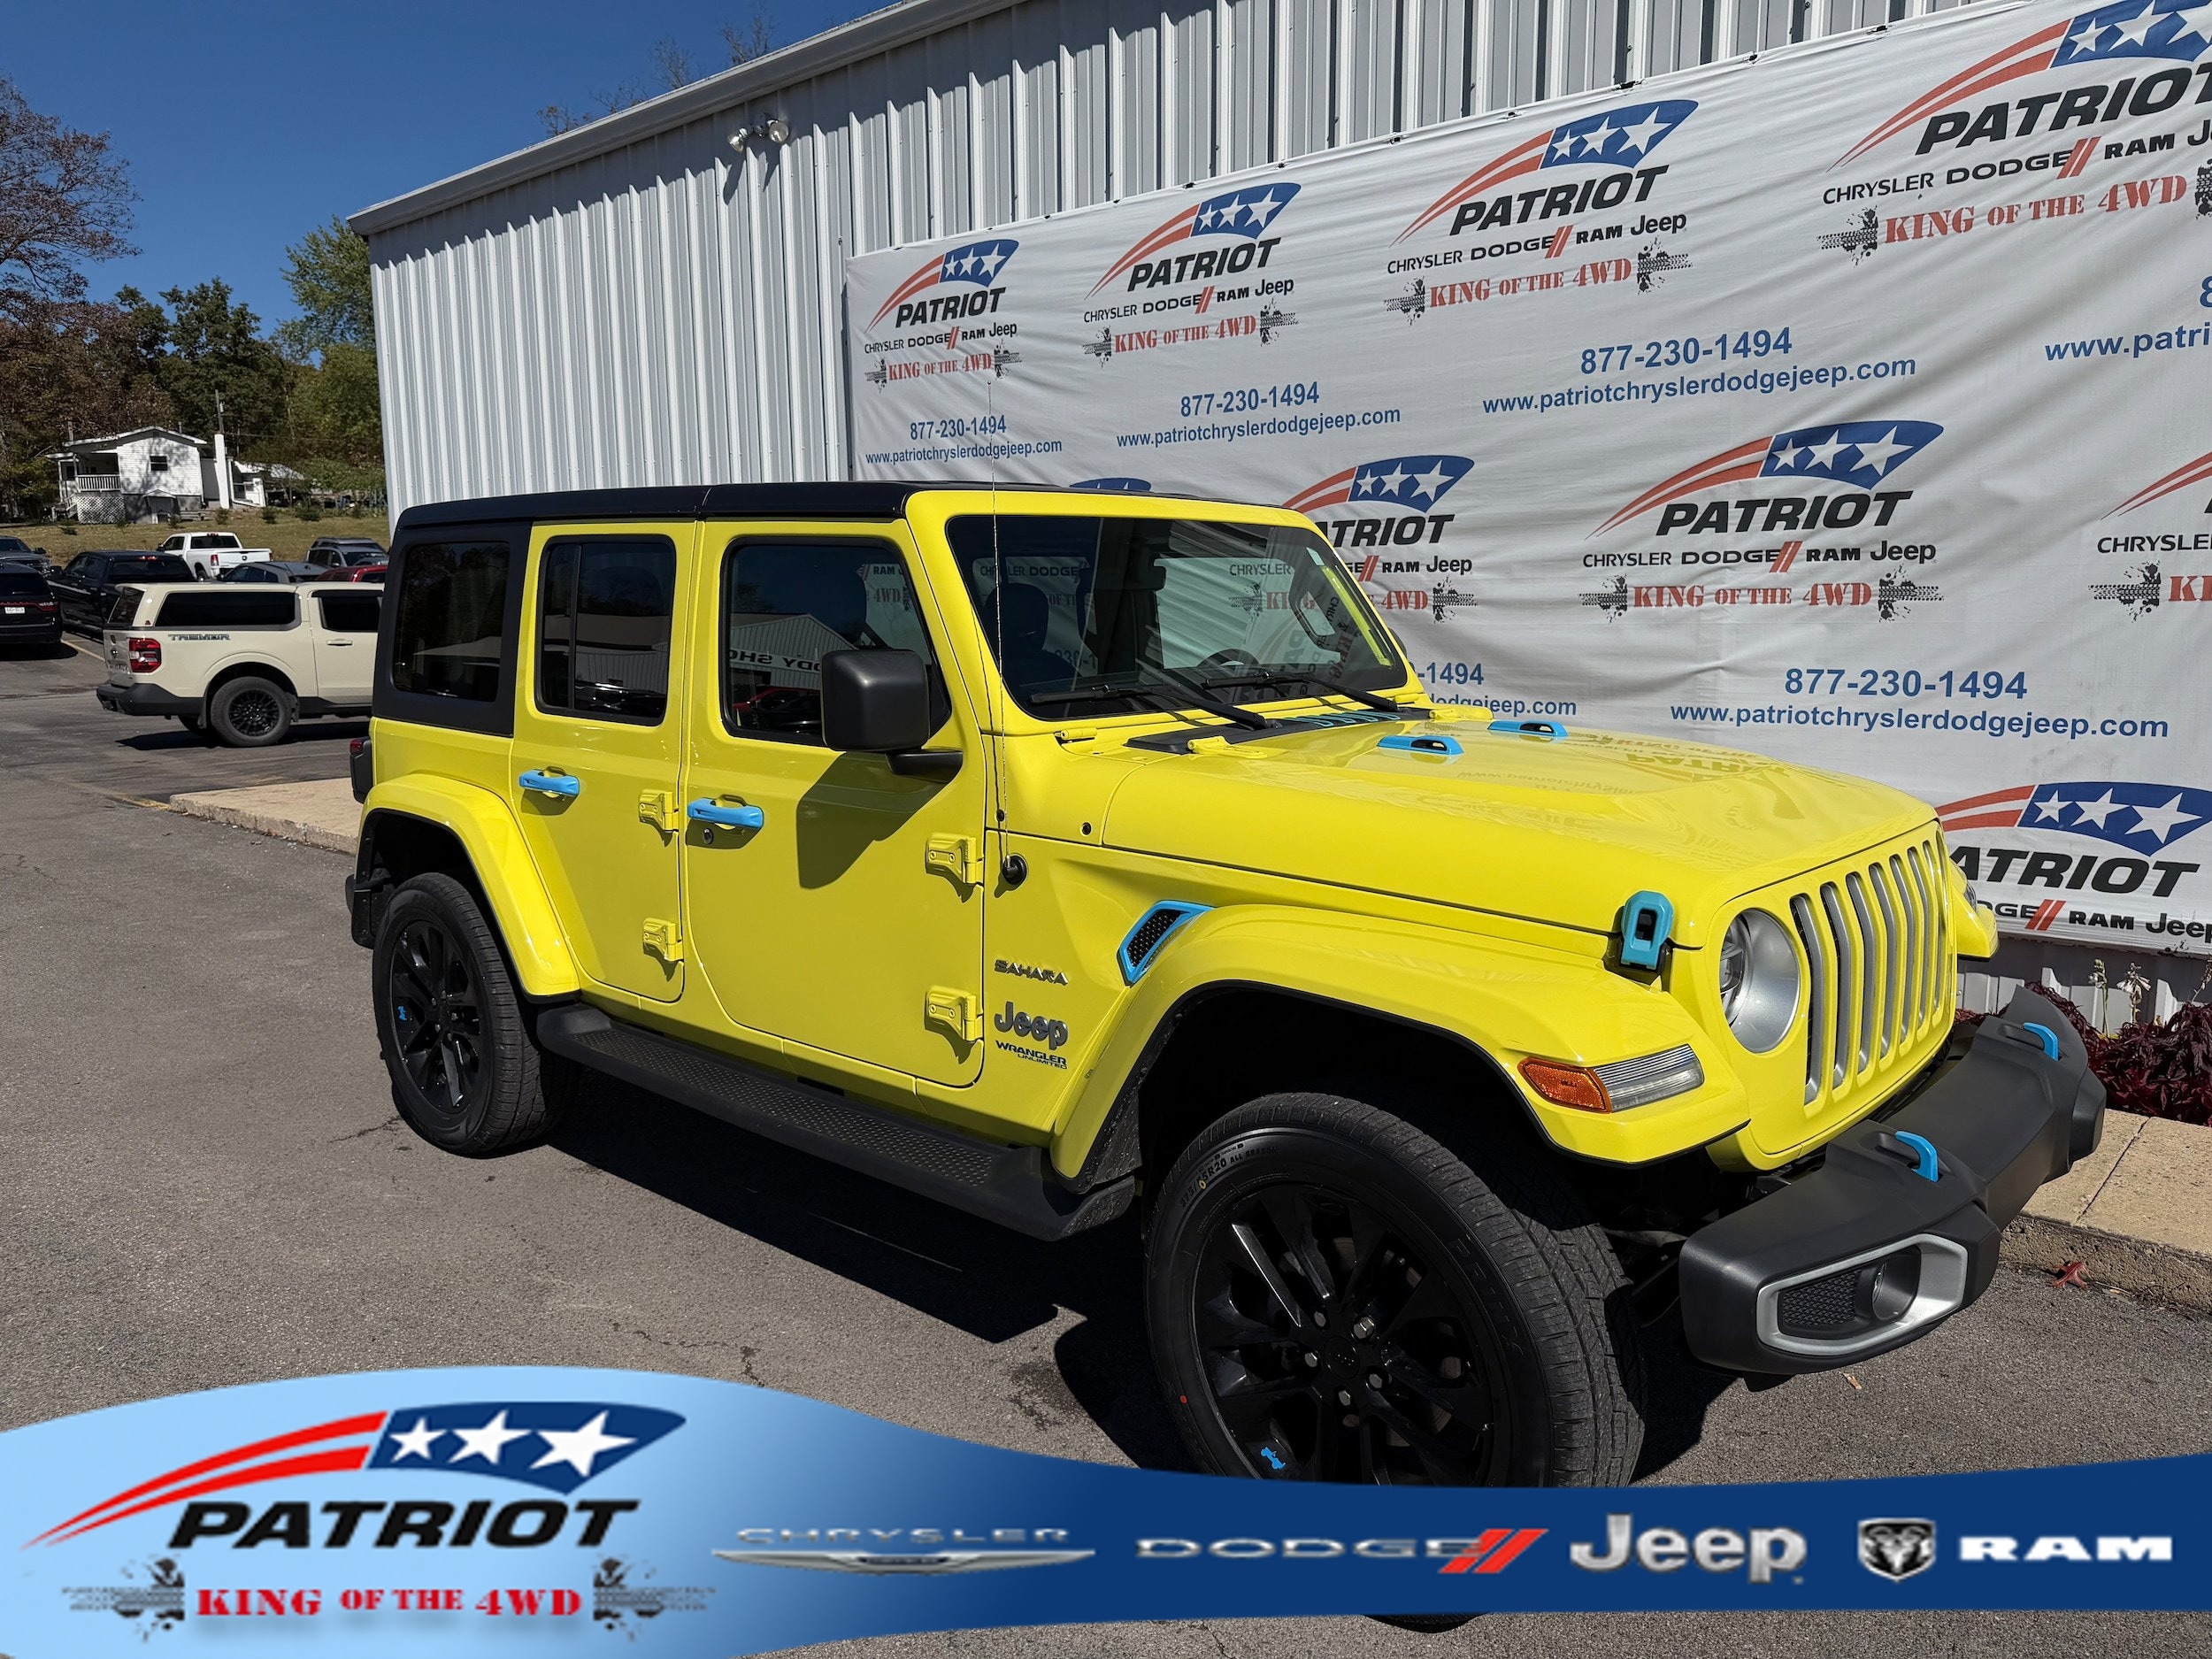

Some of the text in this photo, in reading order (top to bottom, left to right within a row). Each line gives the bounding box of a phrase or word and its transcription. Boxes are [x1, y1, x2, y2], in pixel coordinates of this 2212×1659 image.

[1823, 134, 2175, 204] CHRYSLER DODGE RAM
[1449, 165, 1669, 236] PATRIOT
[1885, 175, 2187, 244] KING OF THE 4WD
[1387, 212, 1687, 274] CHRYSLER DODGE RAM Jeep
[1127, 237, 1282, 293] PATRIOT
[1429, 257, 1632, 308] KING OF THE 4WD
[895, 287, 1006, 328] PATRIOT
[1084, 277, 1295, 324] CHRYSLER DODGE RAM Jeep
[864, 321, 1018, 355] CHRYSLER DODGE RAM Jeep
[1114, 315, 1257, 354] KING OF THE 4WD
[1580, 327, 1792, 375] 877-230-1494
[888, 353, 993, 382] KING OF THE 4WD
[1483, 356, 1916, 414] www.patriotchryslerdodgejeep.com
[1180, 380, 1320, 419] 877-230-1494
[910, 414, 1007, 441] 877-230-1494
[1117, 407, 1402, 449] www.patriotchryslerdodgejeep.com
[865, 439, 1063, 465] www.patriotchryslerdodgejeep.com
[1655, 490, 1914, 536] PATRIOT
[1317, 514, 1455, 548] TRIOT
[2097, 534, 2212, 554] CHRYSLE
[873, 565, 896, 576] RAM
[1382, 561, 1419, 573] RAM
[1426, 556, 1472, 575] Jeep
[1583, 540, 1936, 568] CHRYSLER DODGE RAM Jeep
[872, 587, 902, 603] 4WD
[1381, 590, 1429, 610] 4WD
[1633, 581, 1872, 608] KING OF THE 4WD
[1785, 668, 2027, 699] 877-230-1494
[1671, 705, 2169, 740] www.patriotchryslerdodgejeep.com
[1949, 846, 2200, 897] ATRIOT
[2069, 910, 2134, 930] RAM
[995, 960, 1069, 986] SAHARA
[994, 1001, 1068, 1050] Jeep
[995, 1040, 1067, 1065] WRANGLER
